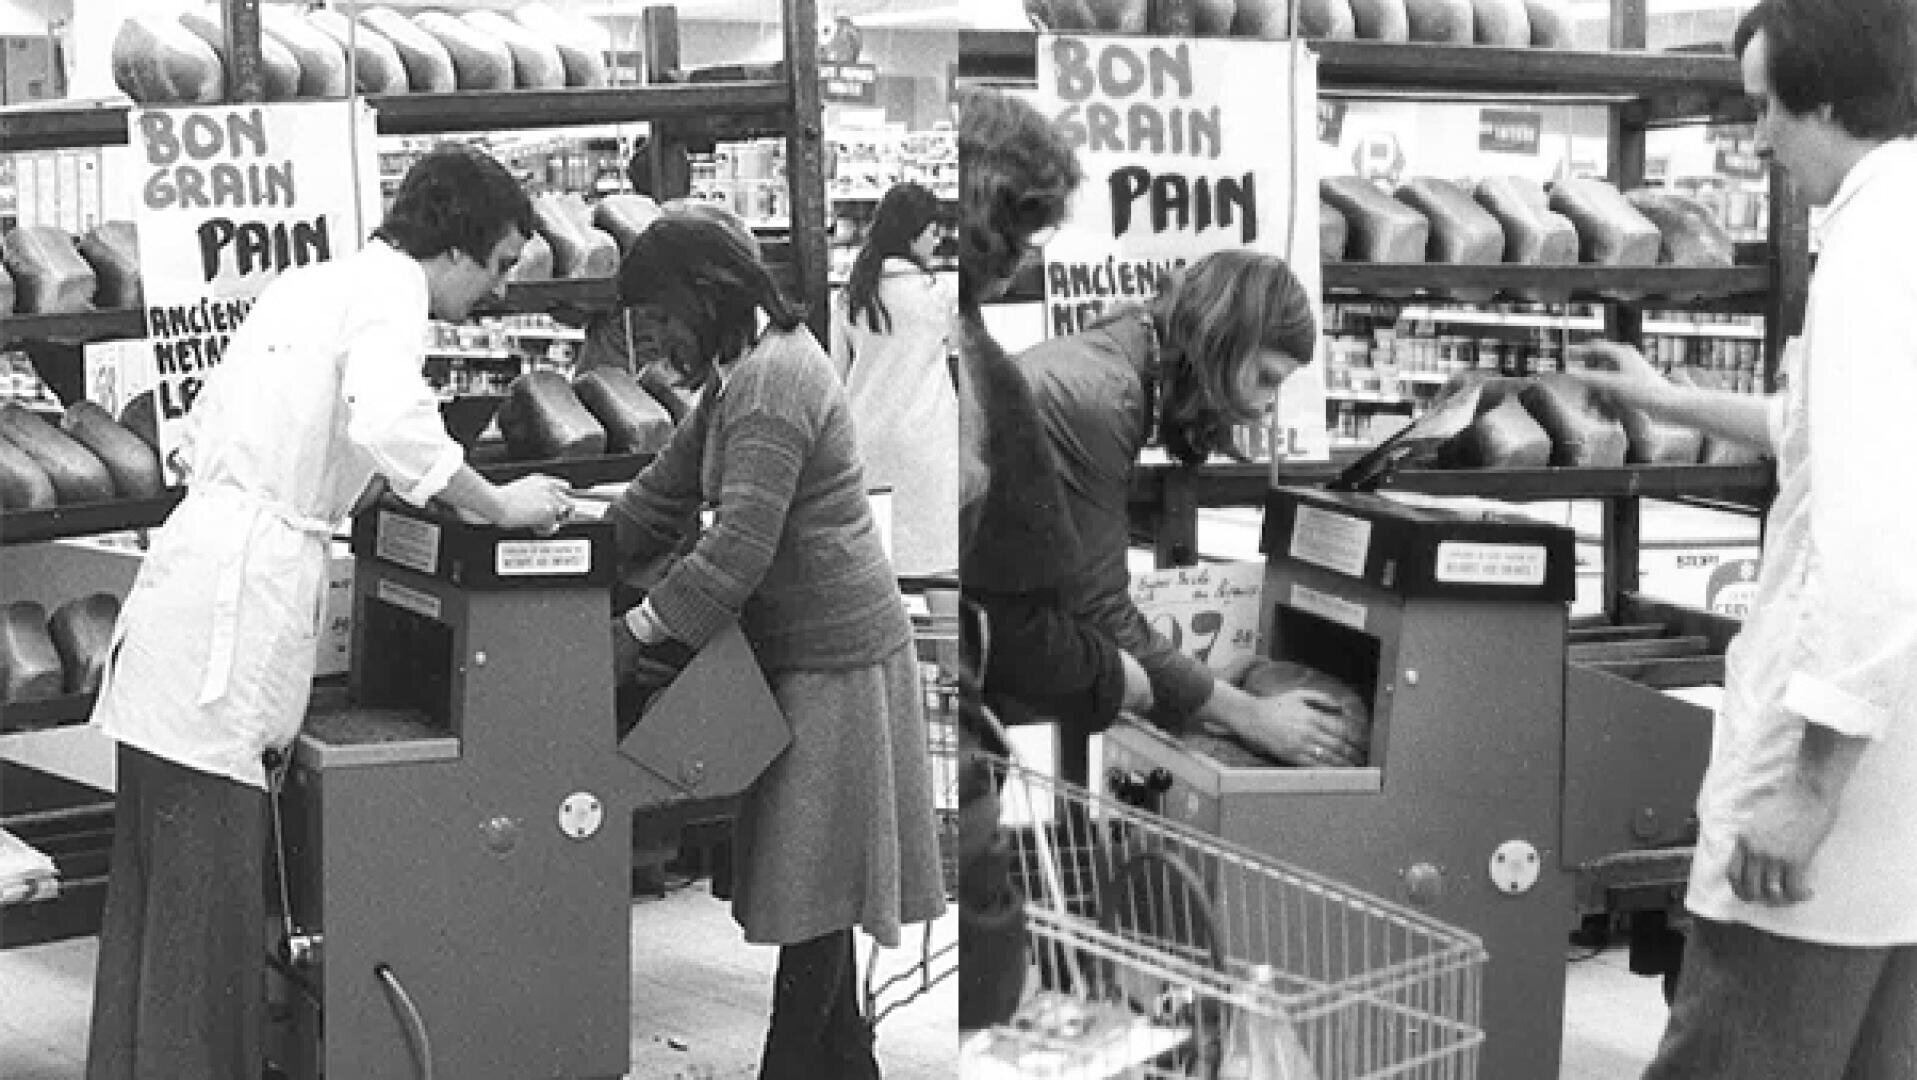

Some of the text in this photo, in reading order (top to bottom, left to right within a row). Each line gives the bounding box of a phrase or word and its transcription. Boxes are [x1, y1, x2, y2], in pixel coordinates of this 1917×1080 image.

[1053, 37, 1193, 100] BON
[139, 109, 267, 165] BON
[144, 160, 296, 210] GRAIN
[1109, 165, 1257, 245] PAIN
[198, 214, 331, 284] PAIN
